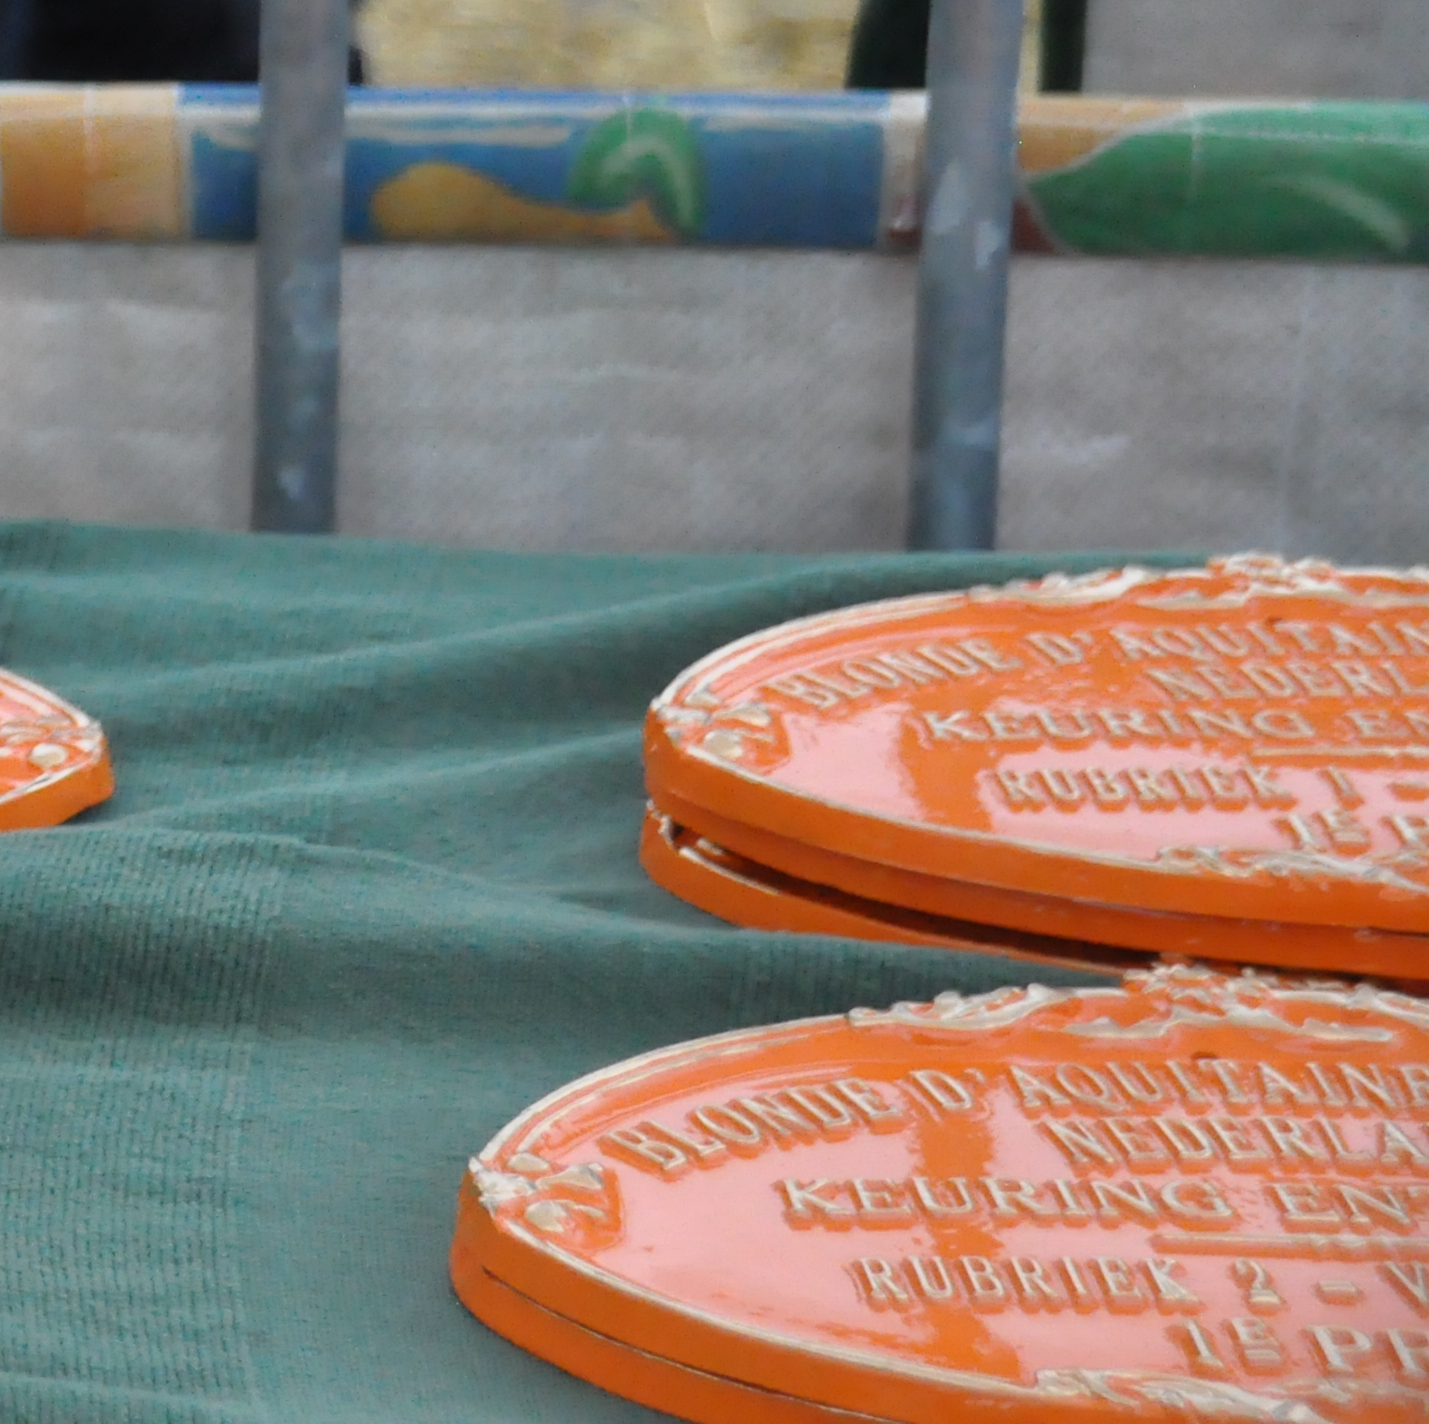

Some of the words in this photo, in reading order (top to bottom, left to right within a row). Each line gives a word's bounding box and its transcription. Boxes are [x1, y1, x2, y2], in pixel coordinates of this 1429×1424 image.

[763, 638, 1022, 709] BLONDE
[923, 708, 1315, 741] KEURING
[998, 763, 1295, 802] RUBRIEK
[606, 1078, 904, 1171] BLONDE
[784, 1178, 1235, 1219] KEURING
[859, 1255, 1200, 1303] RUBRIEK
[1233, 1256, 1284, 1305] 2
